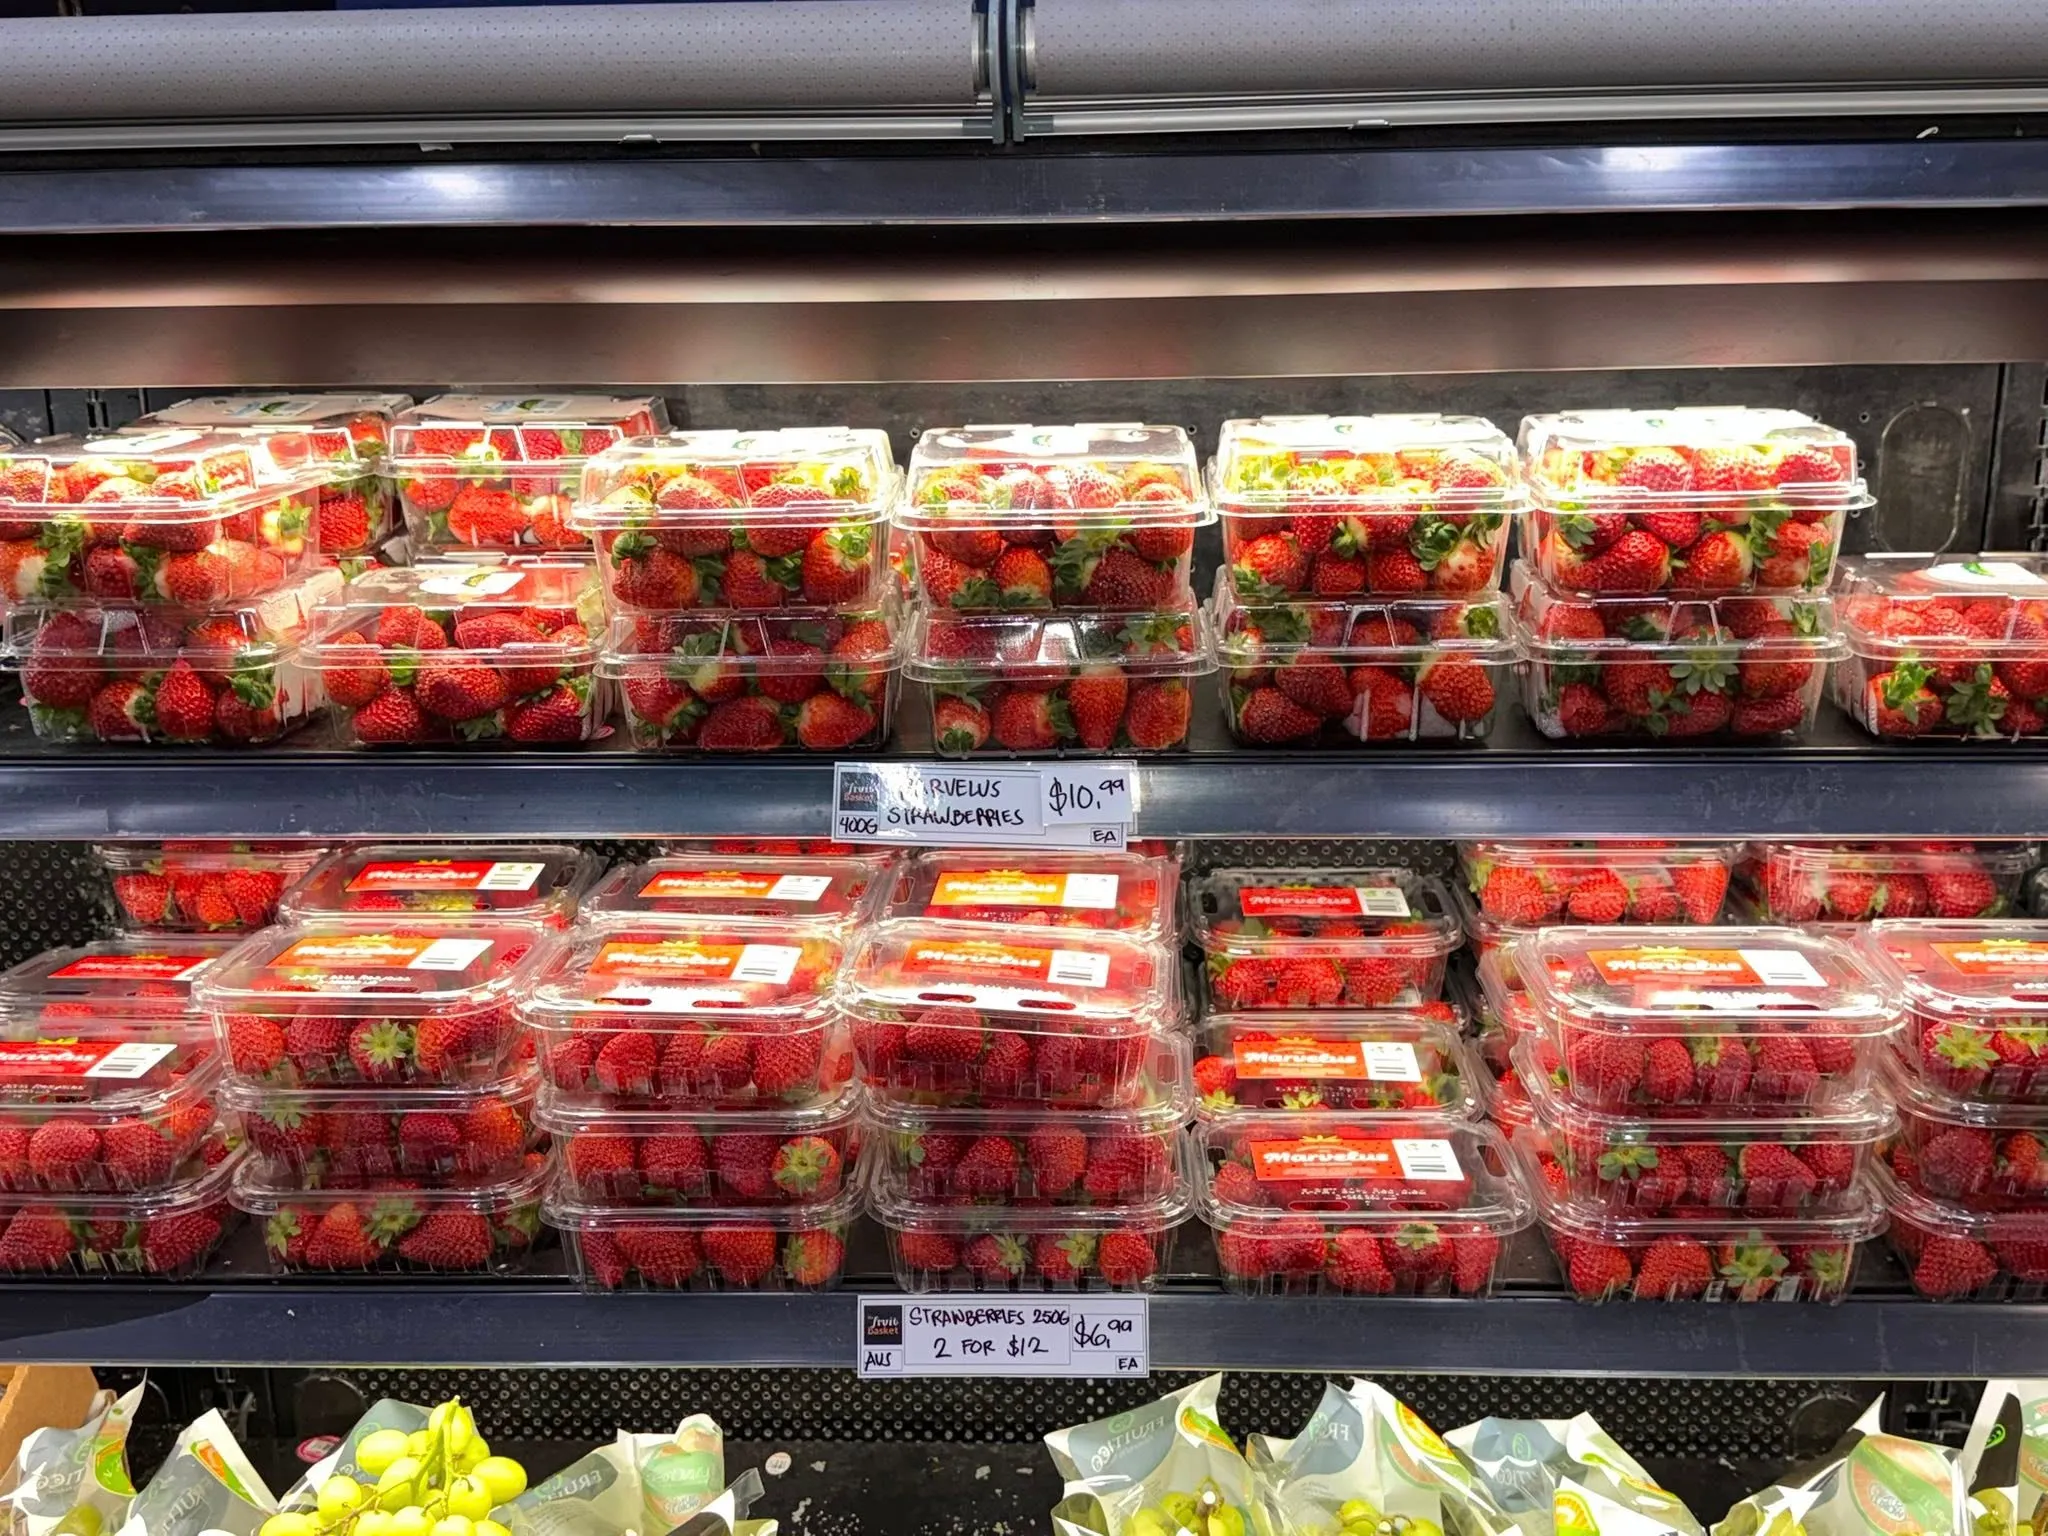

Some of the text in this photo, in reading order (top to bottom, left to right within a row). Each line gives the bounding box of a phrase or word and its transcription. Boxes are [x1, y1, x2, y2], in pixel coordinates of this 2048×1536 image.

[887, 806, 1024, 828] STRAWBERRIES
[839, 817, 878, 834] 400G
[1093, 830, 1116, 843] EA
[1263, 1150, 1389, 1164] Marvelus
[870, 1315, 899, 1328] fruit
[909, 1306, 1069, 1328] STRAWBERRIES 250G
[934, 1334, 1049, 1358] 2 FOR $12
[1118, 1357, 1138, 1370] EA
